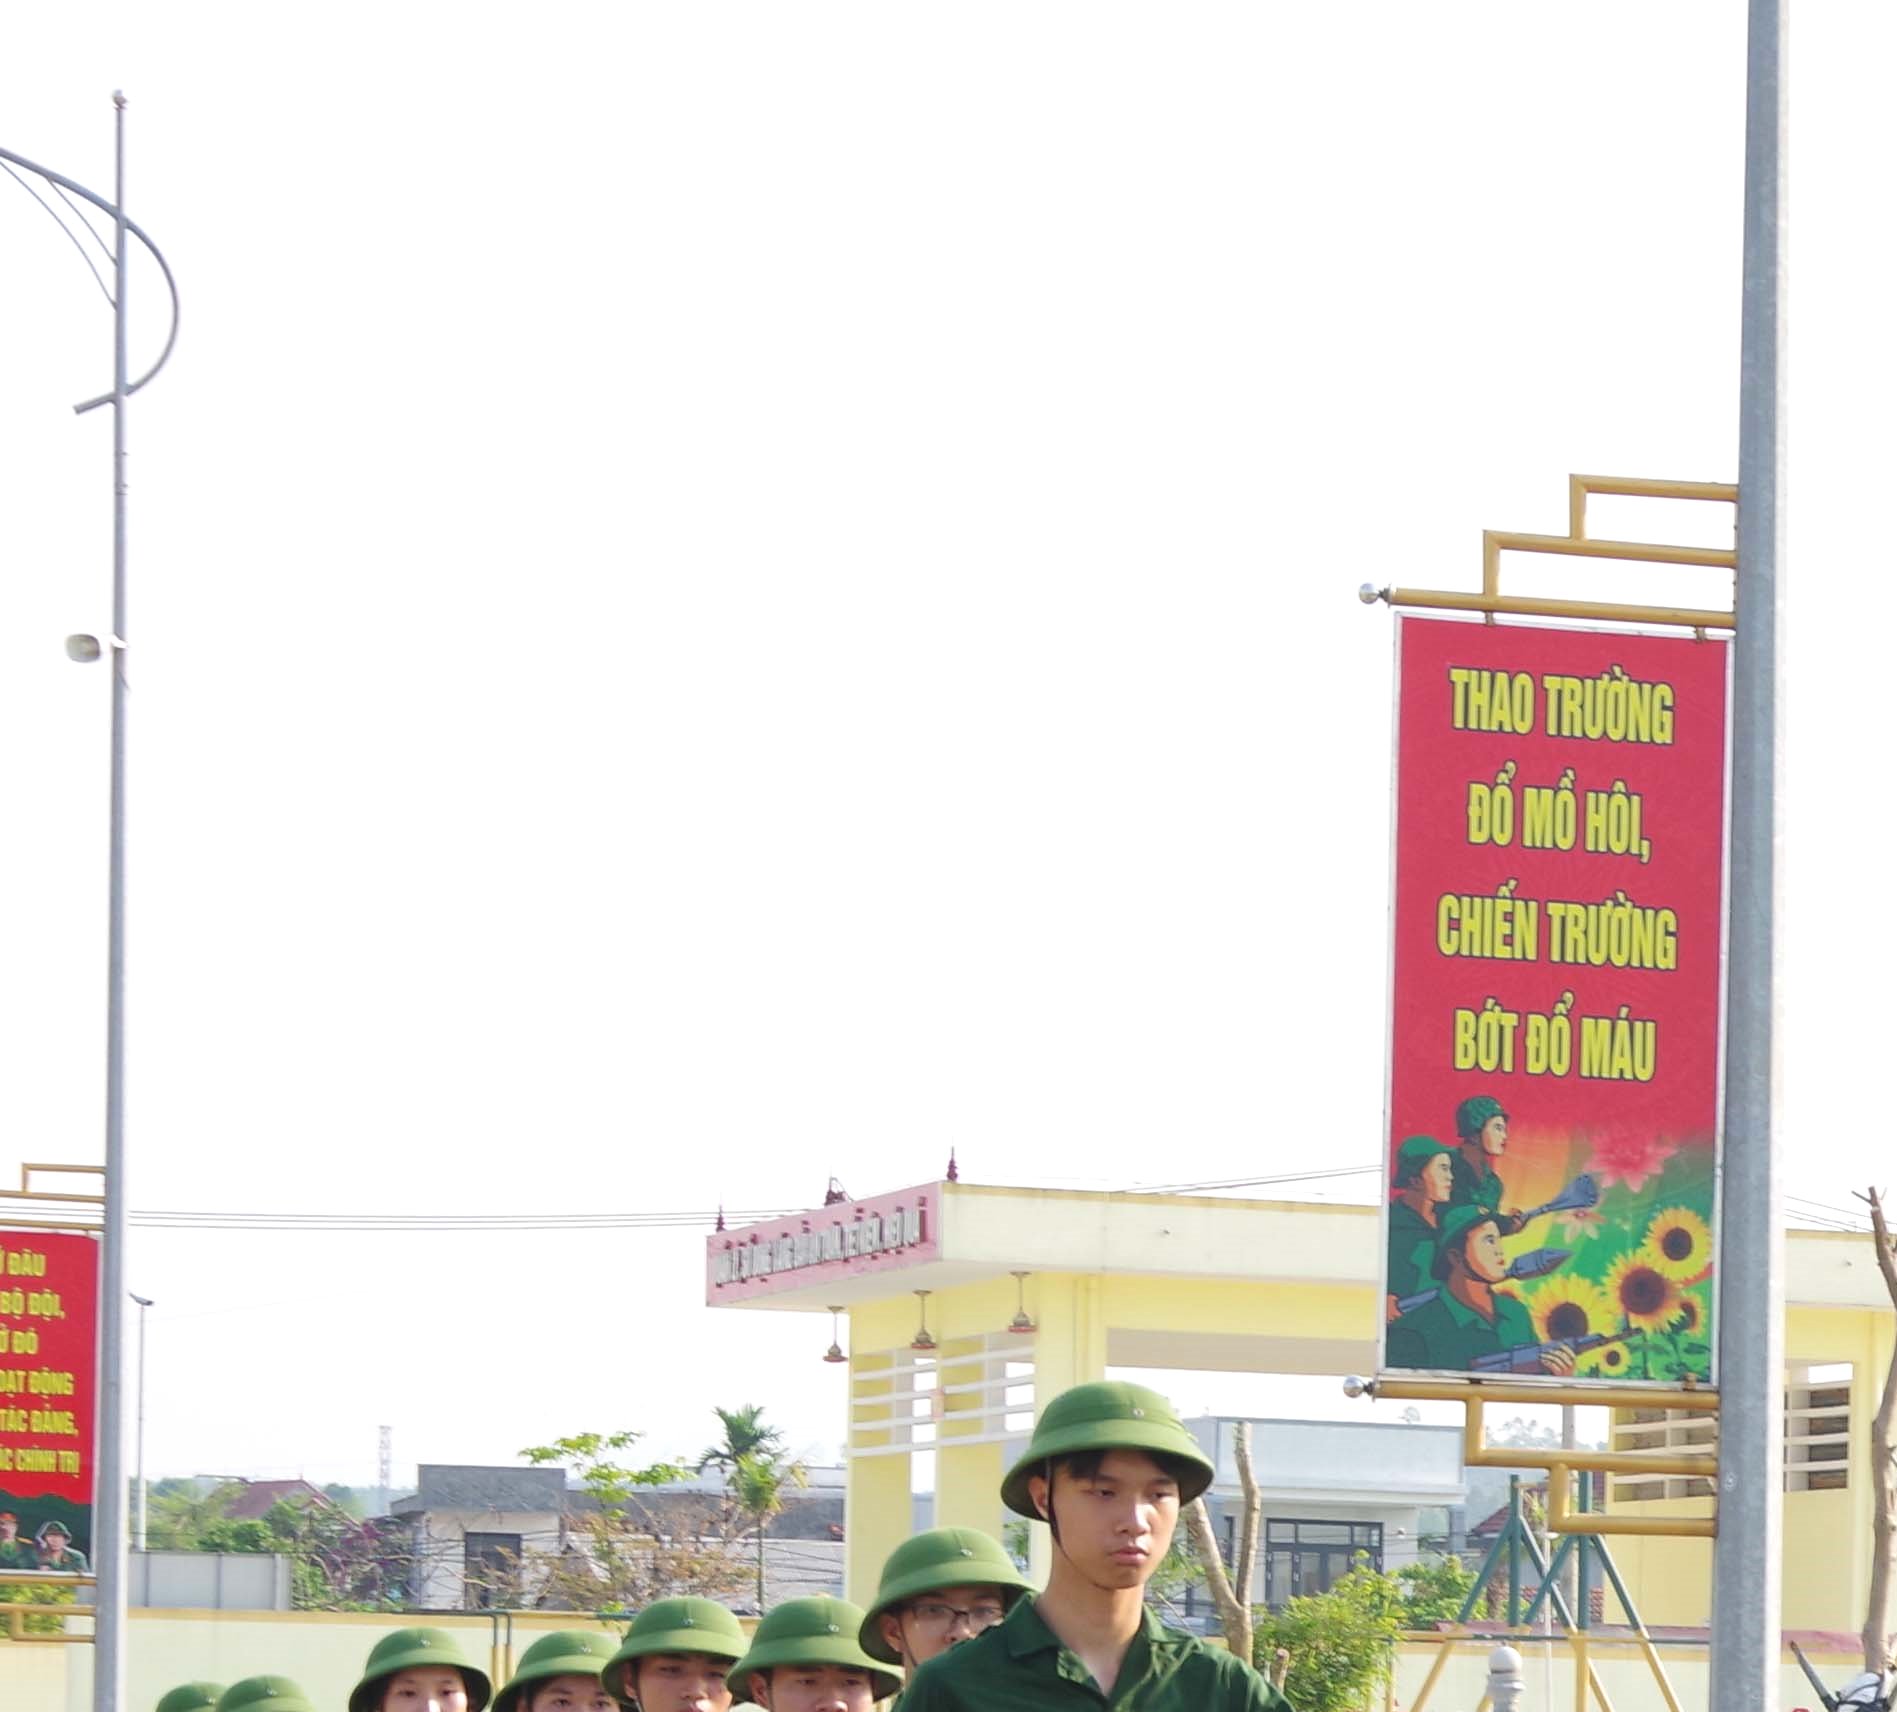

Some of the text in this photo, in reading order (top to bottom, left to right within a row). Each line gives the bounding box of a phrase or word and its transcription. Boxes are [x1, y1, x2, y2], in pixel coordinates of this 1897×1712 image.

[1449, 664, 1675, 745] THAO TRƯỜNG
[1466, 760, 1652, 863] ĐỔ MỒ HÔI,
[1436, 878, 1678, 971] CHIẾN TRƯỜNG
[1453, 991, 1657, 1082] BỚT ĐỔ MÁU
